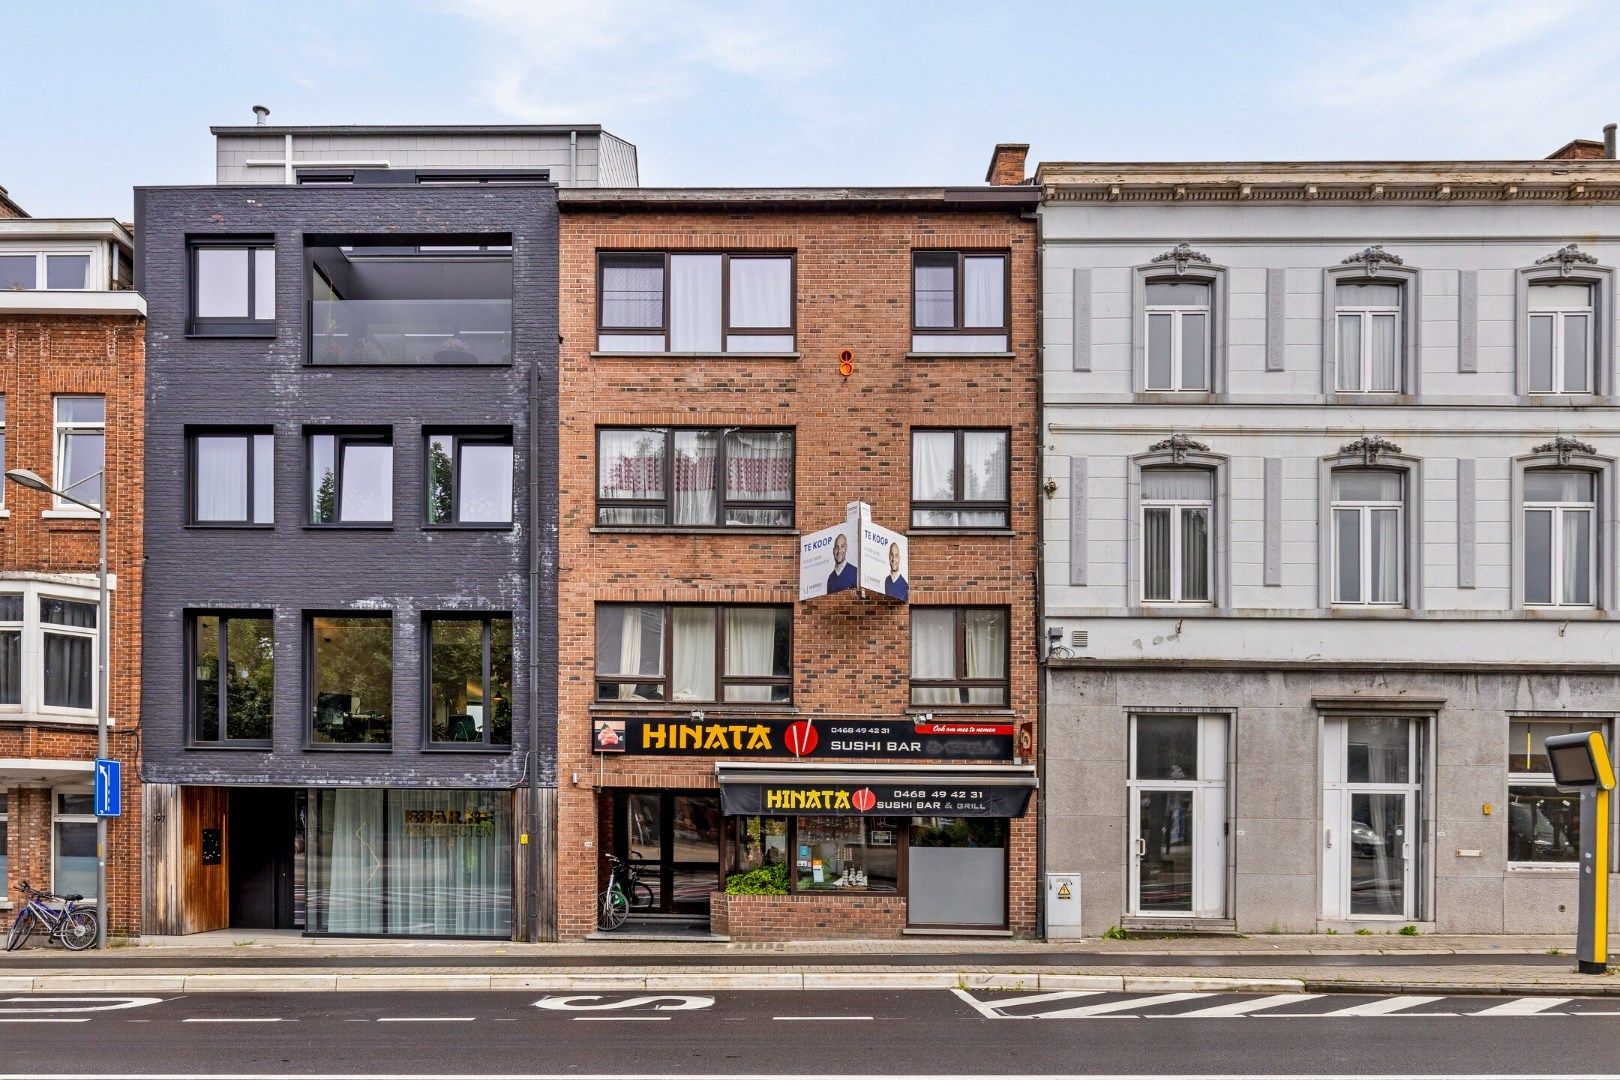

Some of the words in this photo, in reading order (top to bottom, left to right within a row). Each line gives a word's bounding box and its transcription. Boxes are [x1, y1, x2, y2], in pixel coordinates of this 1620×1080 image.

[804, 542, 812, 552] TE
[812, 536, 833, 549] KOOP
[865, 530, 872, 540] TE
[872, 533, 888, 546] KOOP
[643, 724, 772, 750] HINATA
[830, 740, 881, 751] SUSHI
[886, 741, 922, 752] BAR
[767, 790, 850, 809] HINATA
[951, 791, 966, 799] 42
[876, 801, 913, 810] SUSHI
[916, 802, 941, 810] BAR
